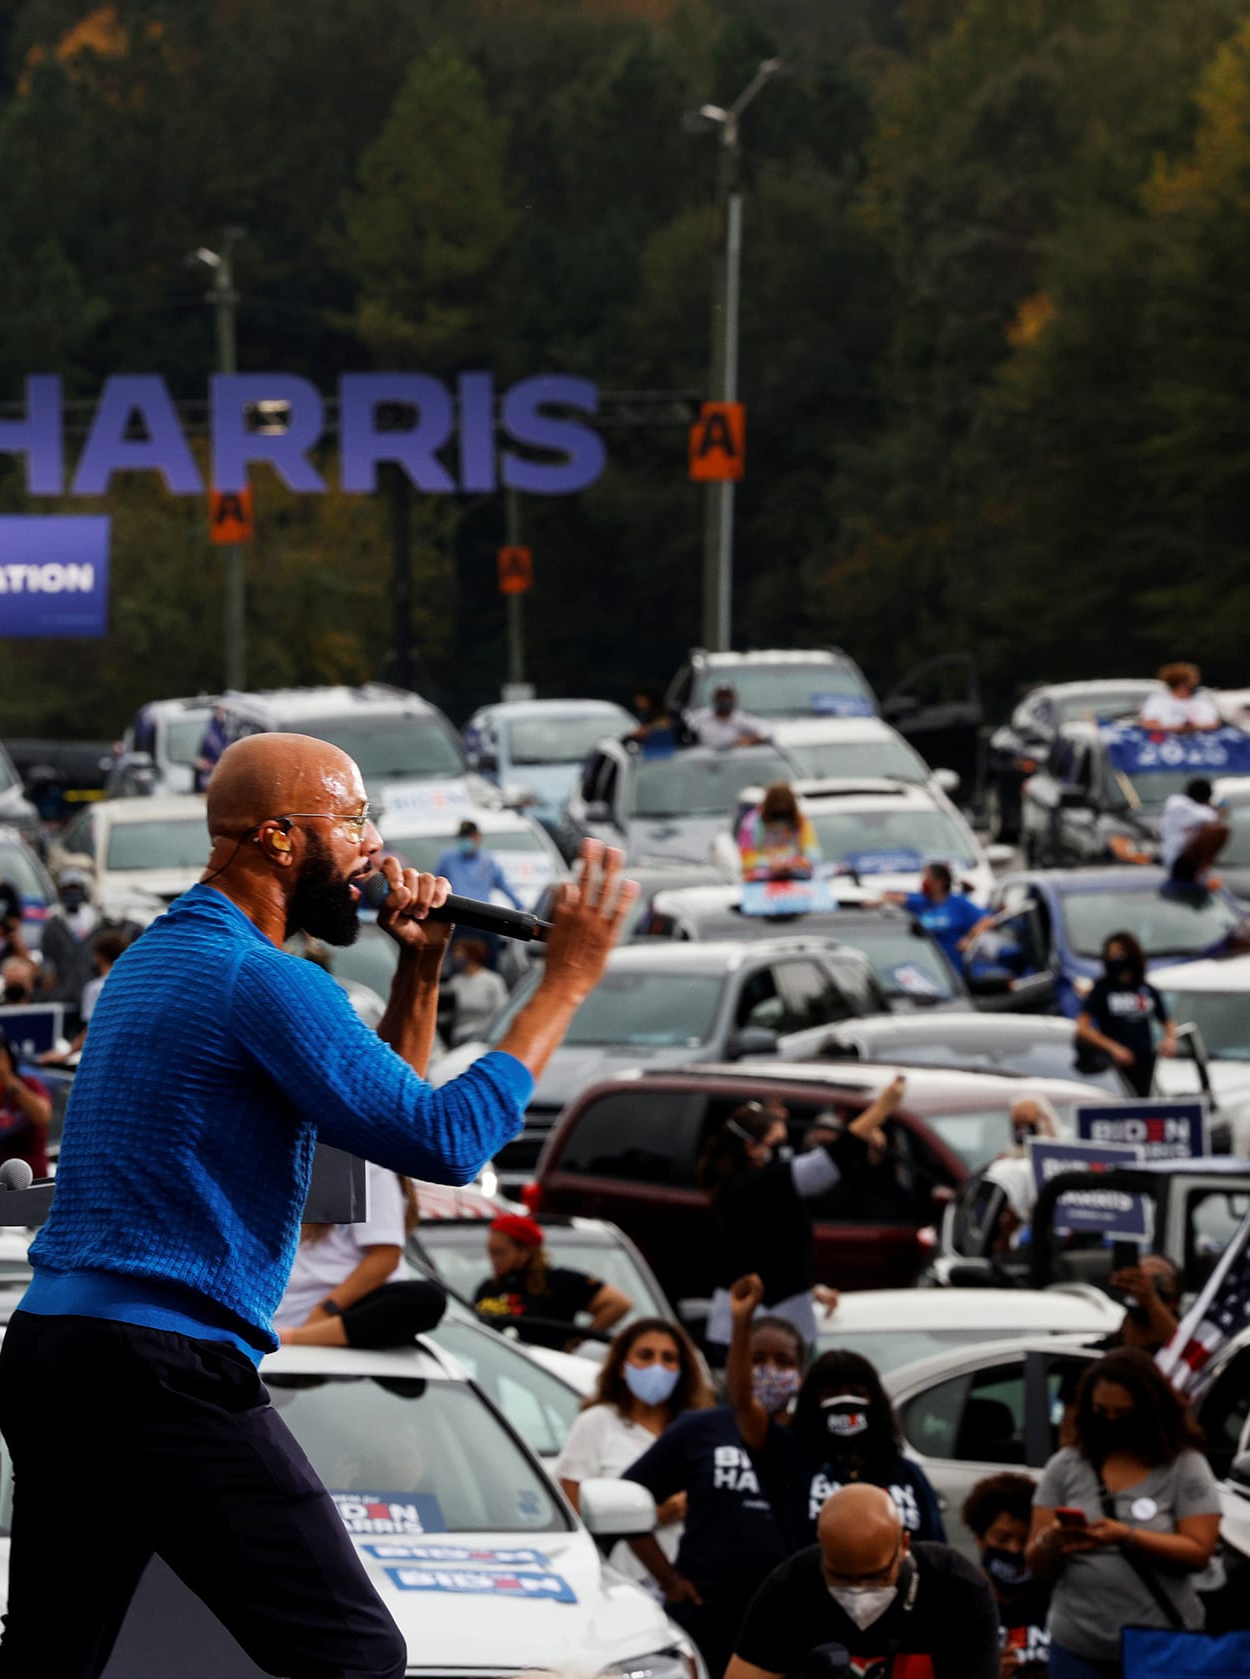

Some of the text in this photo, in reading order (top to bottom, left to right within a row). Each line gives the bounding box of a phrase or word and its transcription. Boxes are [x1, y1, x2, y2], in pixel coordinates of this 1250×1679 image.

[699, 411, 735, 459] A
[215, 490, 246, 526] A
[1091, 1117, 1190, 1145] BIDEN
[335, 1504, 421, 1521] DEN
[397, 1569, 562, 1593] BIDEN
